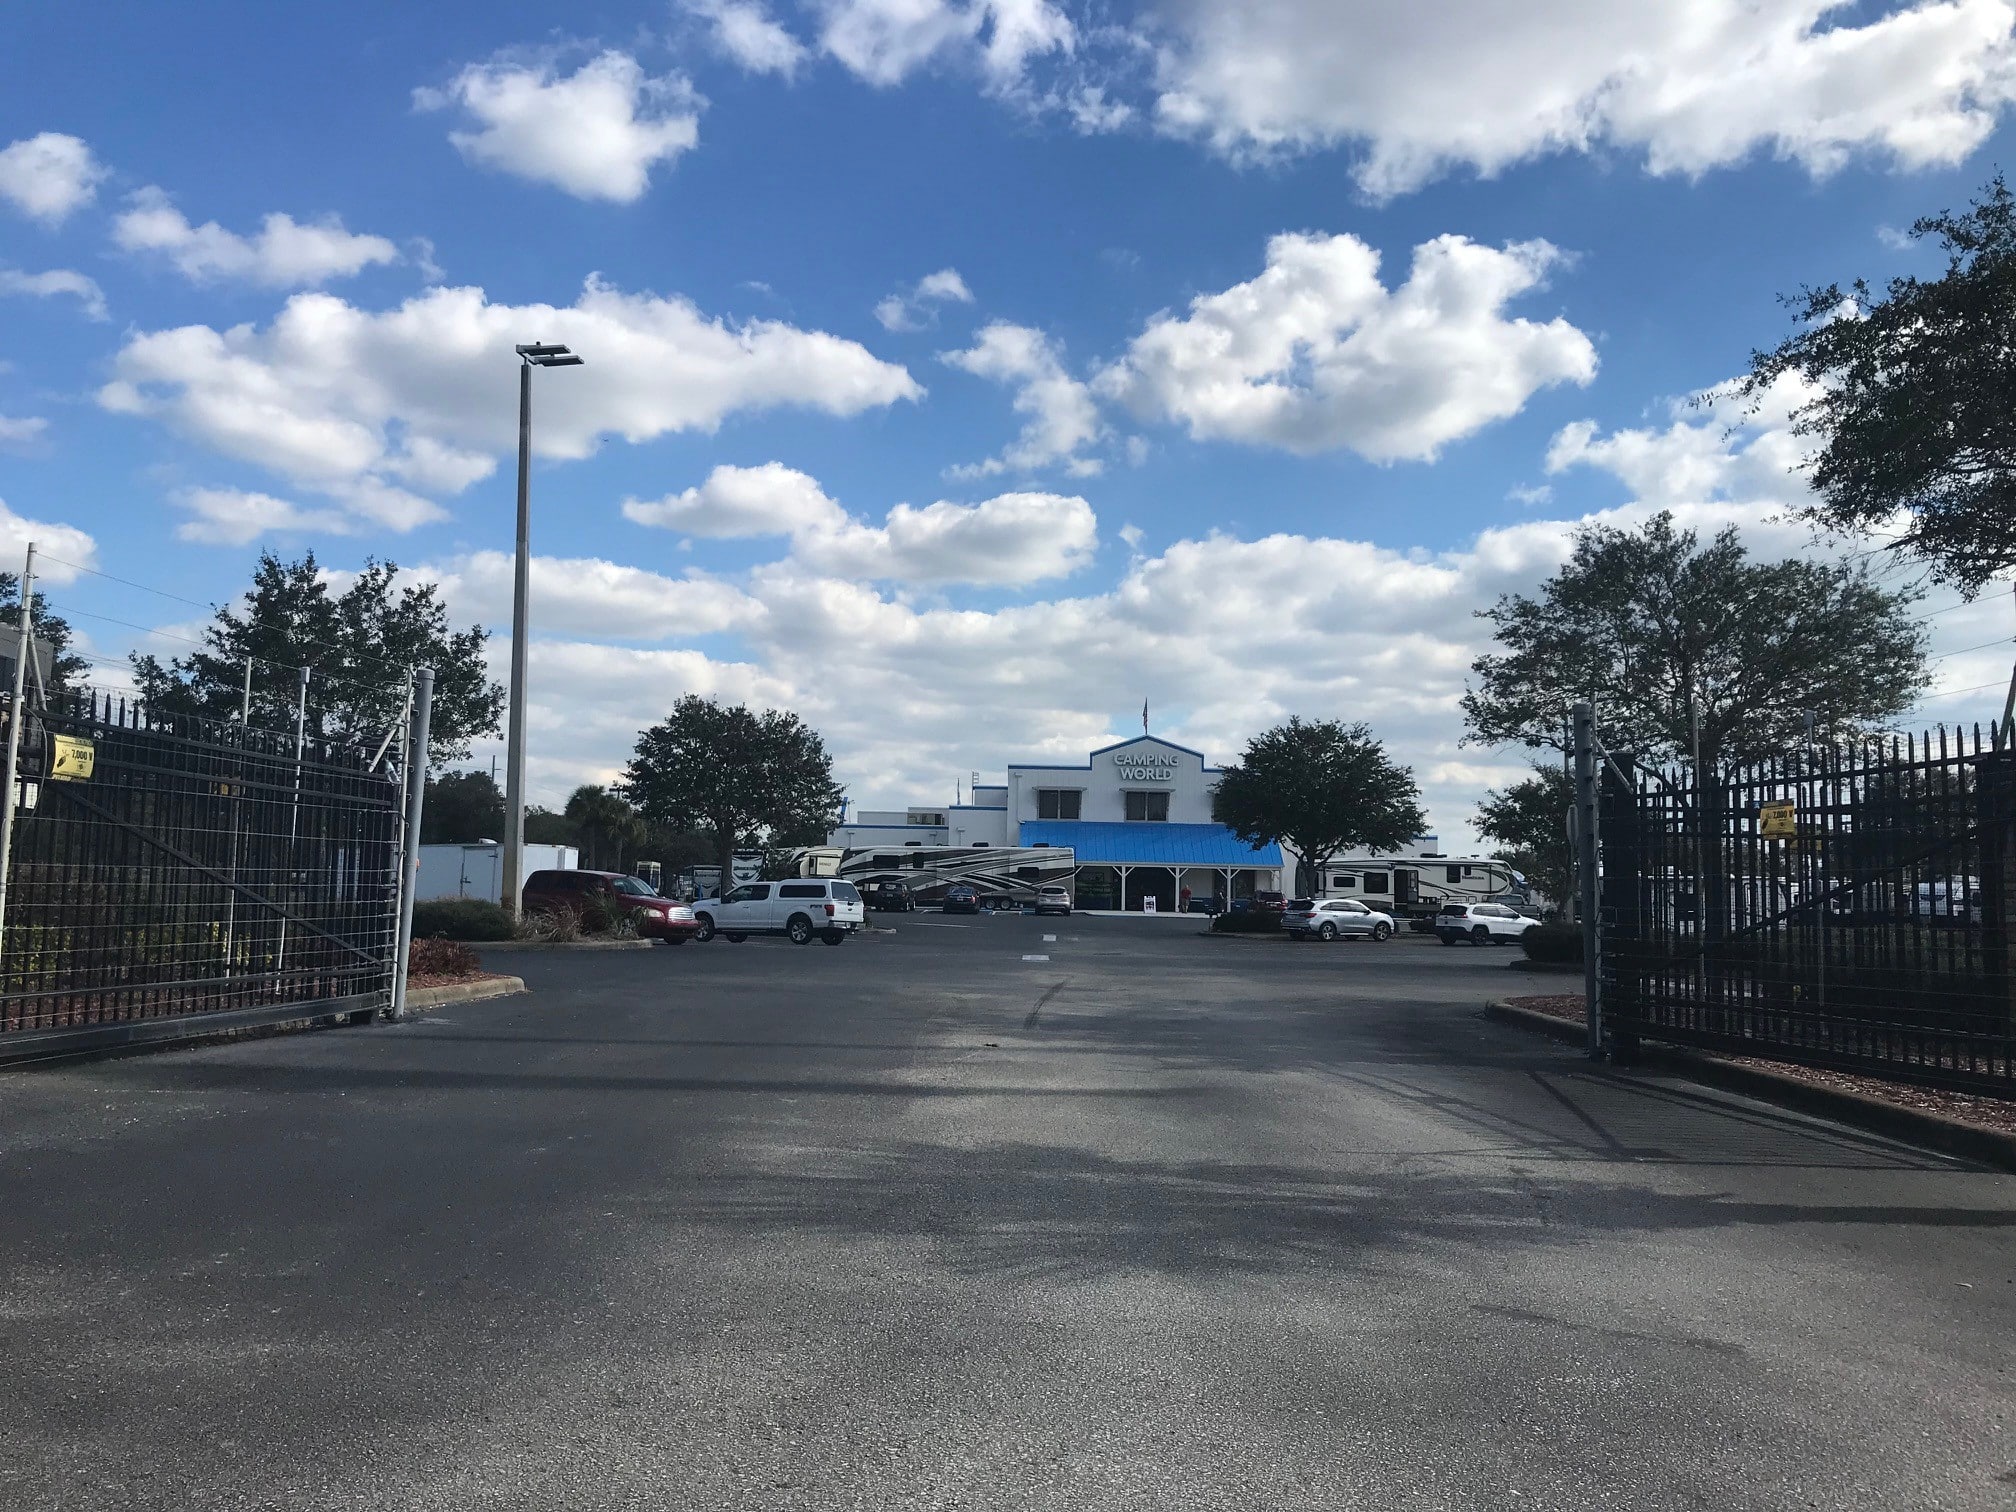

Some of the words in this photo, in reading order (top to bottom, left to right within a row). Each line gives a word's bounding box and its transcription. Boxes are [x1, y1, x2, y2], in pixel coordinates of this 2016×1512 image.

[71, 749, 88, 761] 7,000
[1113, 753, 1179, 767] CAMPING
[1120, 767, 1172, 781] WORLD
